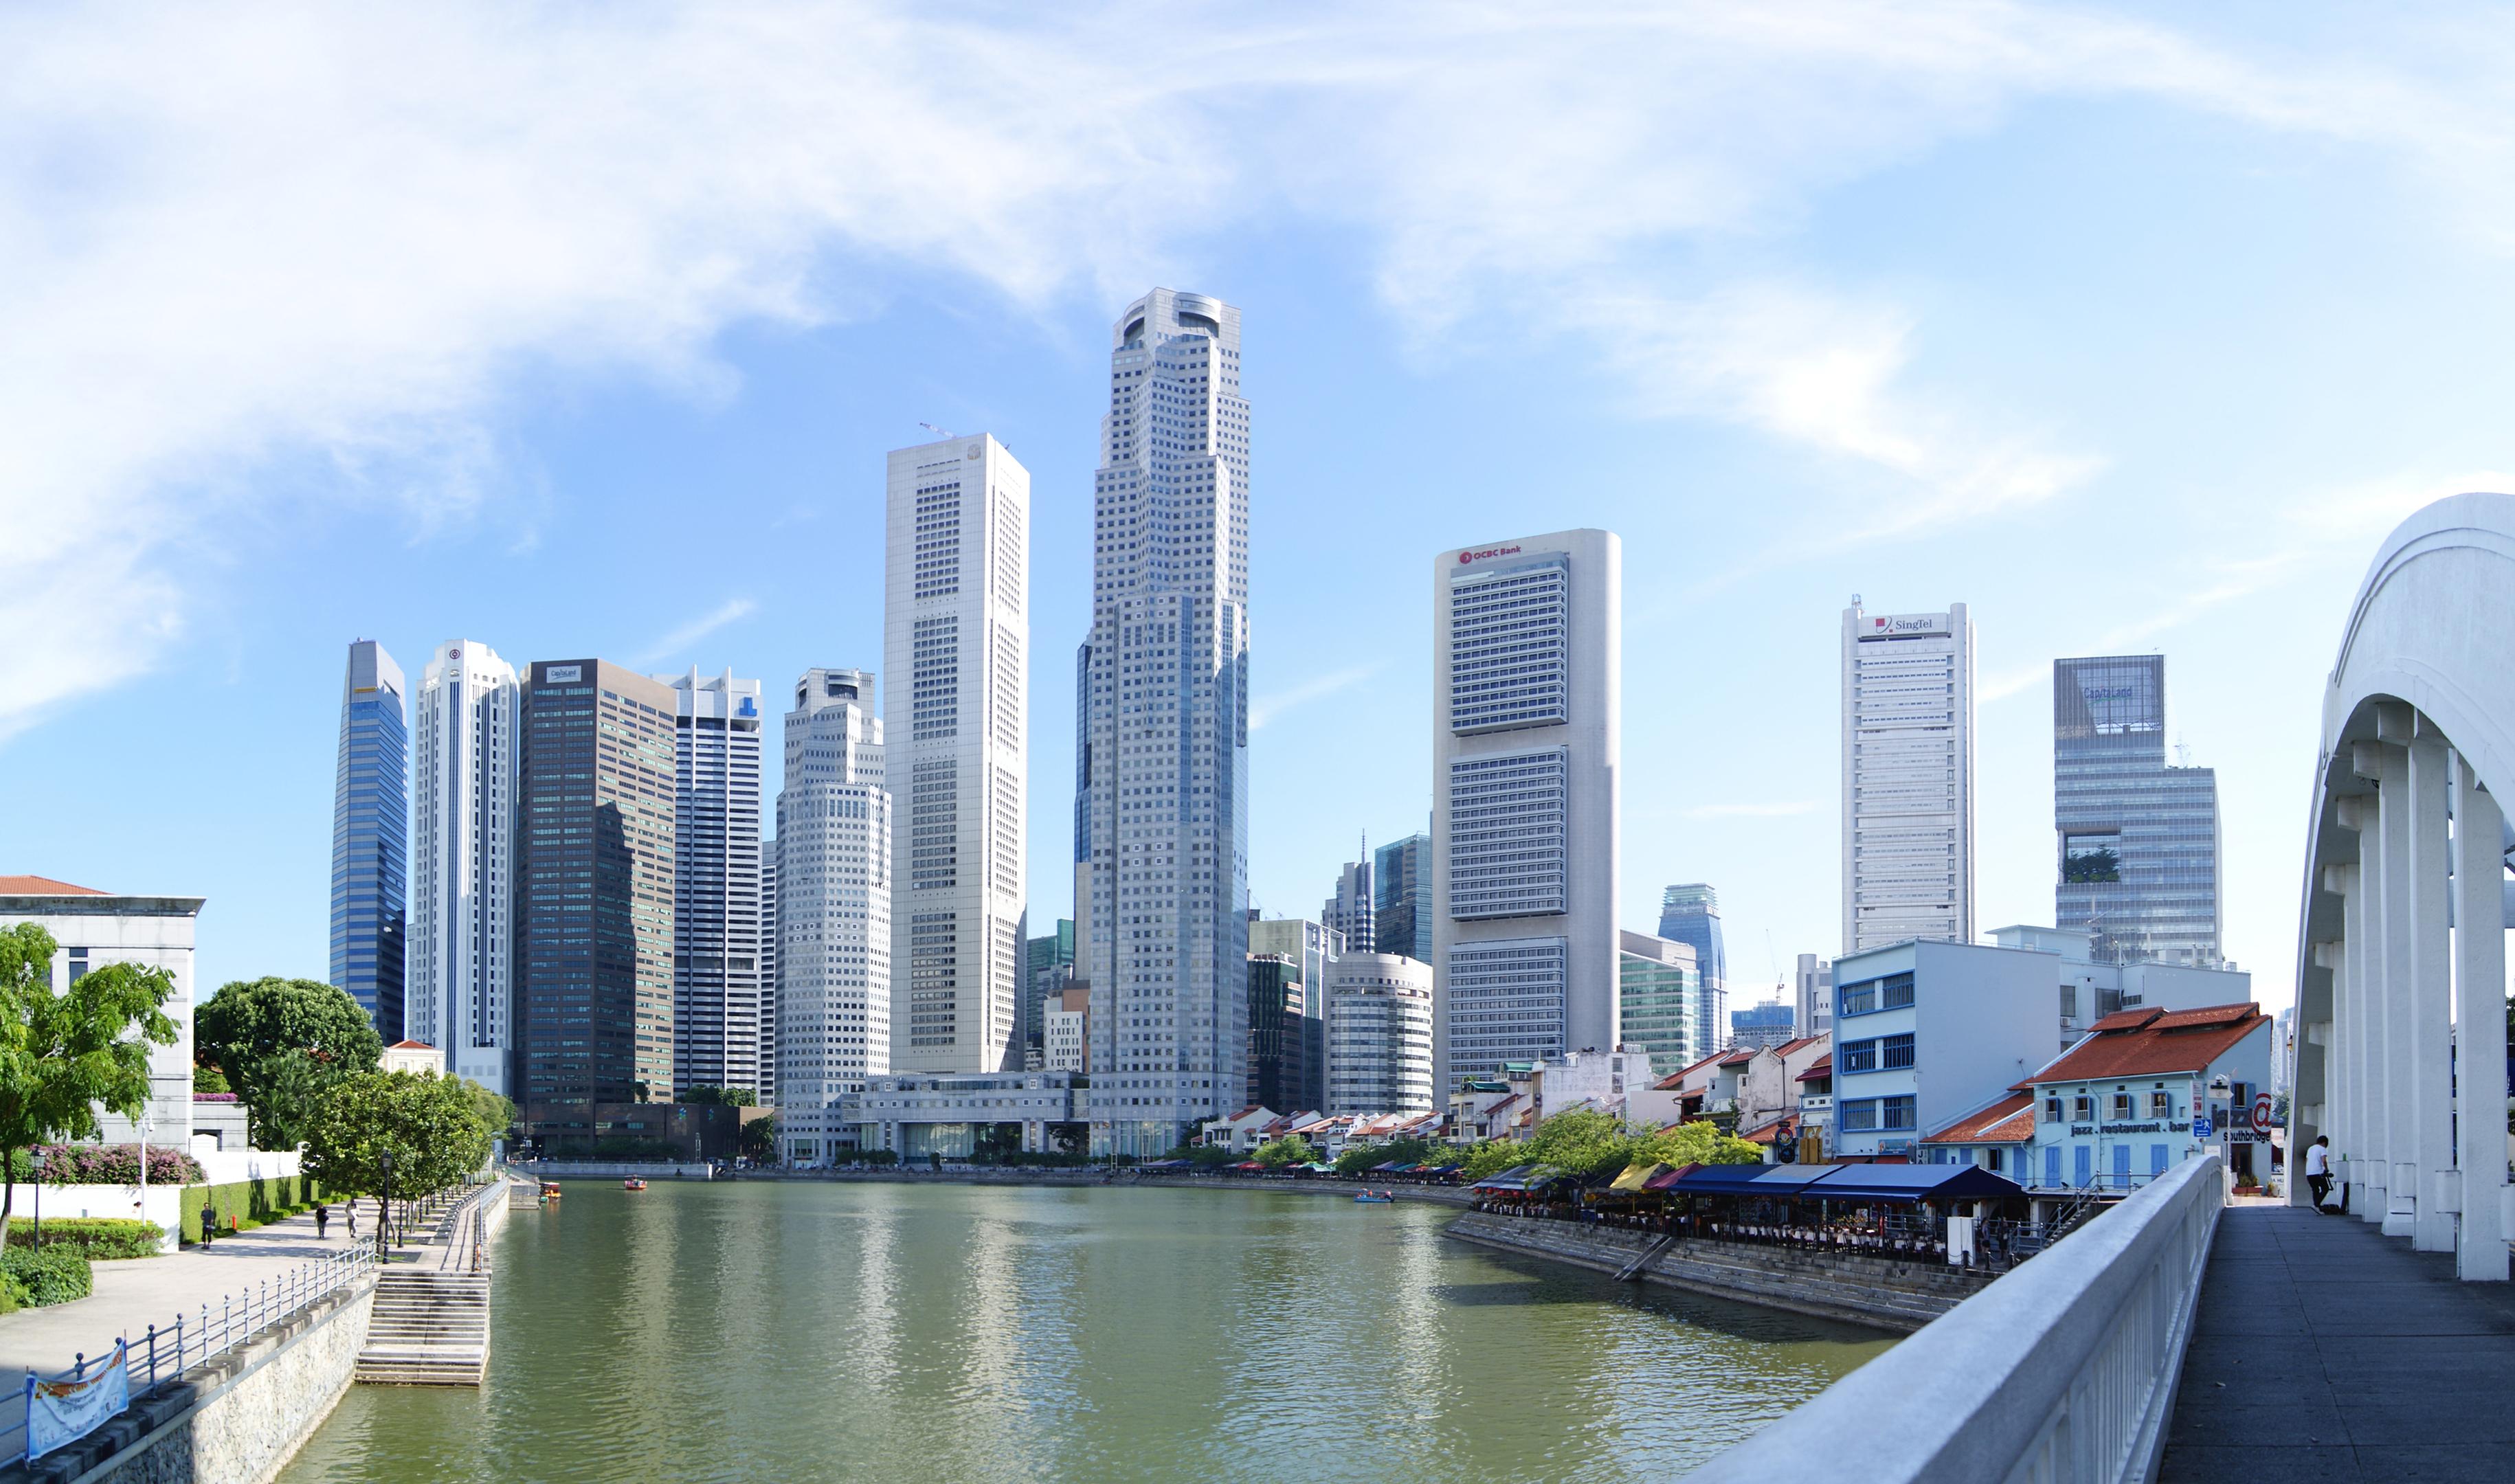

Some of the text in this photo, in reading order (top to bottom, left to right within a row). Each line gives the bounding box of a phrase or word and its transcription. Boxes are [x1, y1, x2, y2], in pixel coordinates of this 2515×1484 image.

[1473, 545, 1521, 559] OCBC Bank
[1896, 619, 1932, 631] SingTel
[2083, 685, 2132, 700] CapitaLand
[2070, 1121, 2190, 1137] jazz restaurant bar
